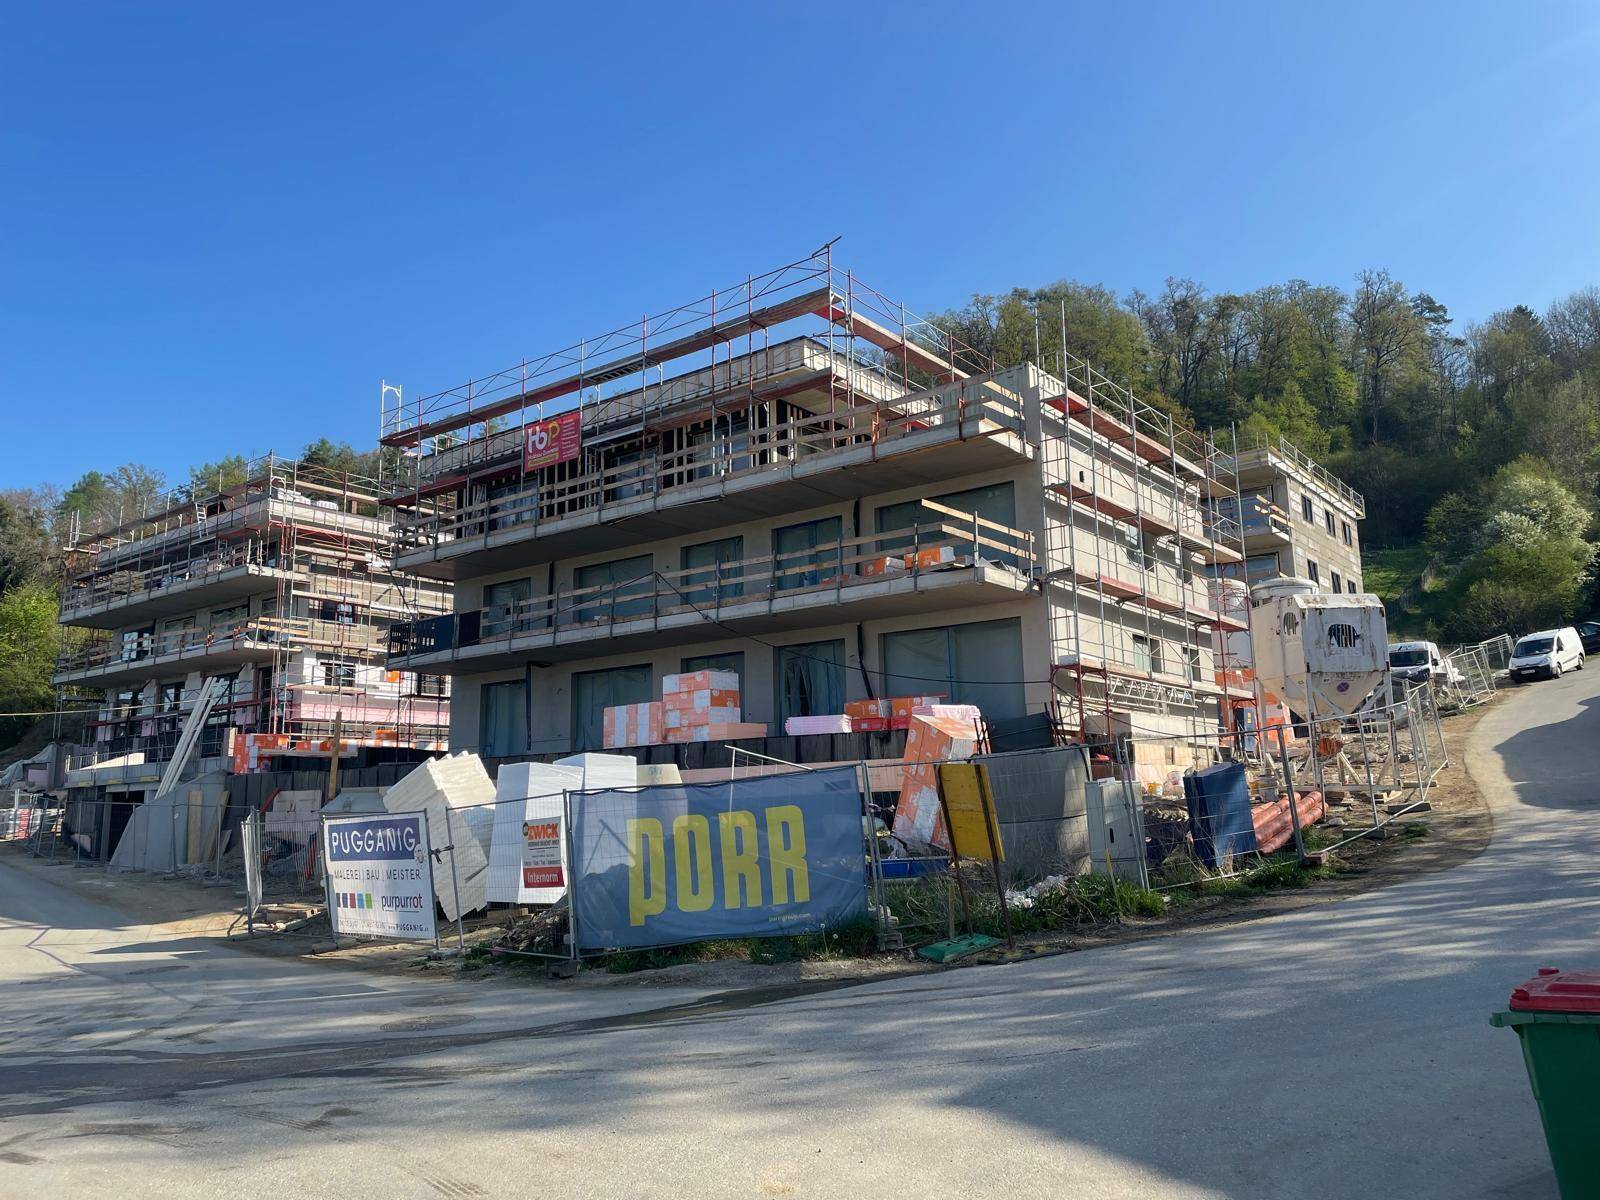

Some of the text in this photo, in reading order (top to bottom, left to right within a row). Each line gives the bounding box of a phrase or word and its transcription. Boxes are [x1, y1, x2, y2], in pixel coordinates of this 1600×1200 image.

[331, 826, 416, 854] PUGGANIG
[334, 868, 422, 880] MALEREI BAU MEISTER
[527, 871, 559, 884] Internorm
[381, 893, 423, 911] purpurrot
